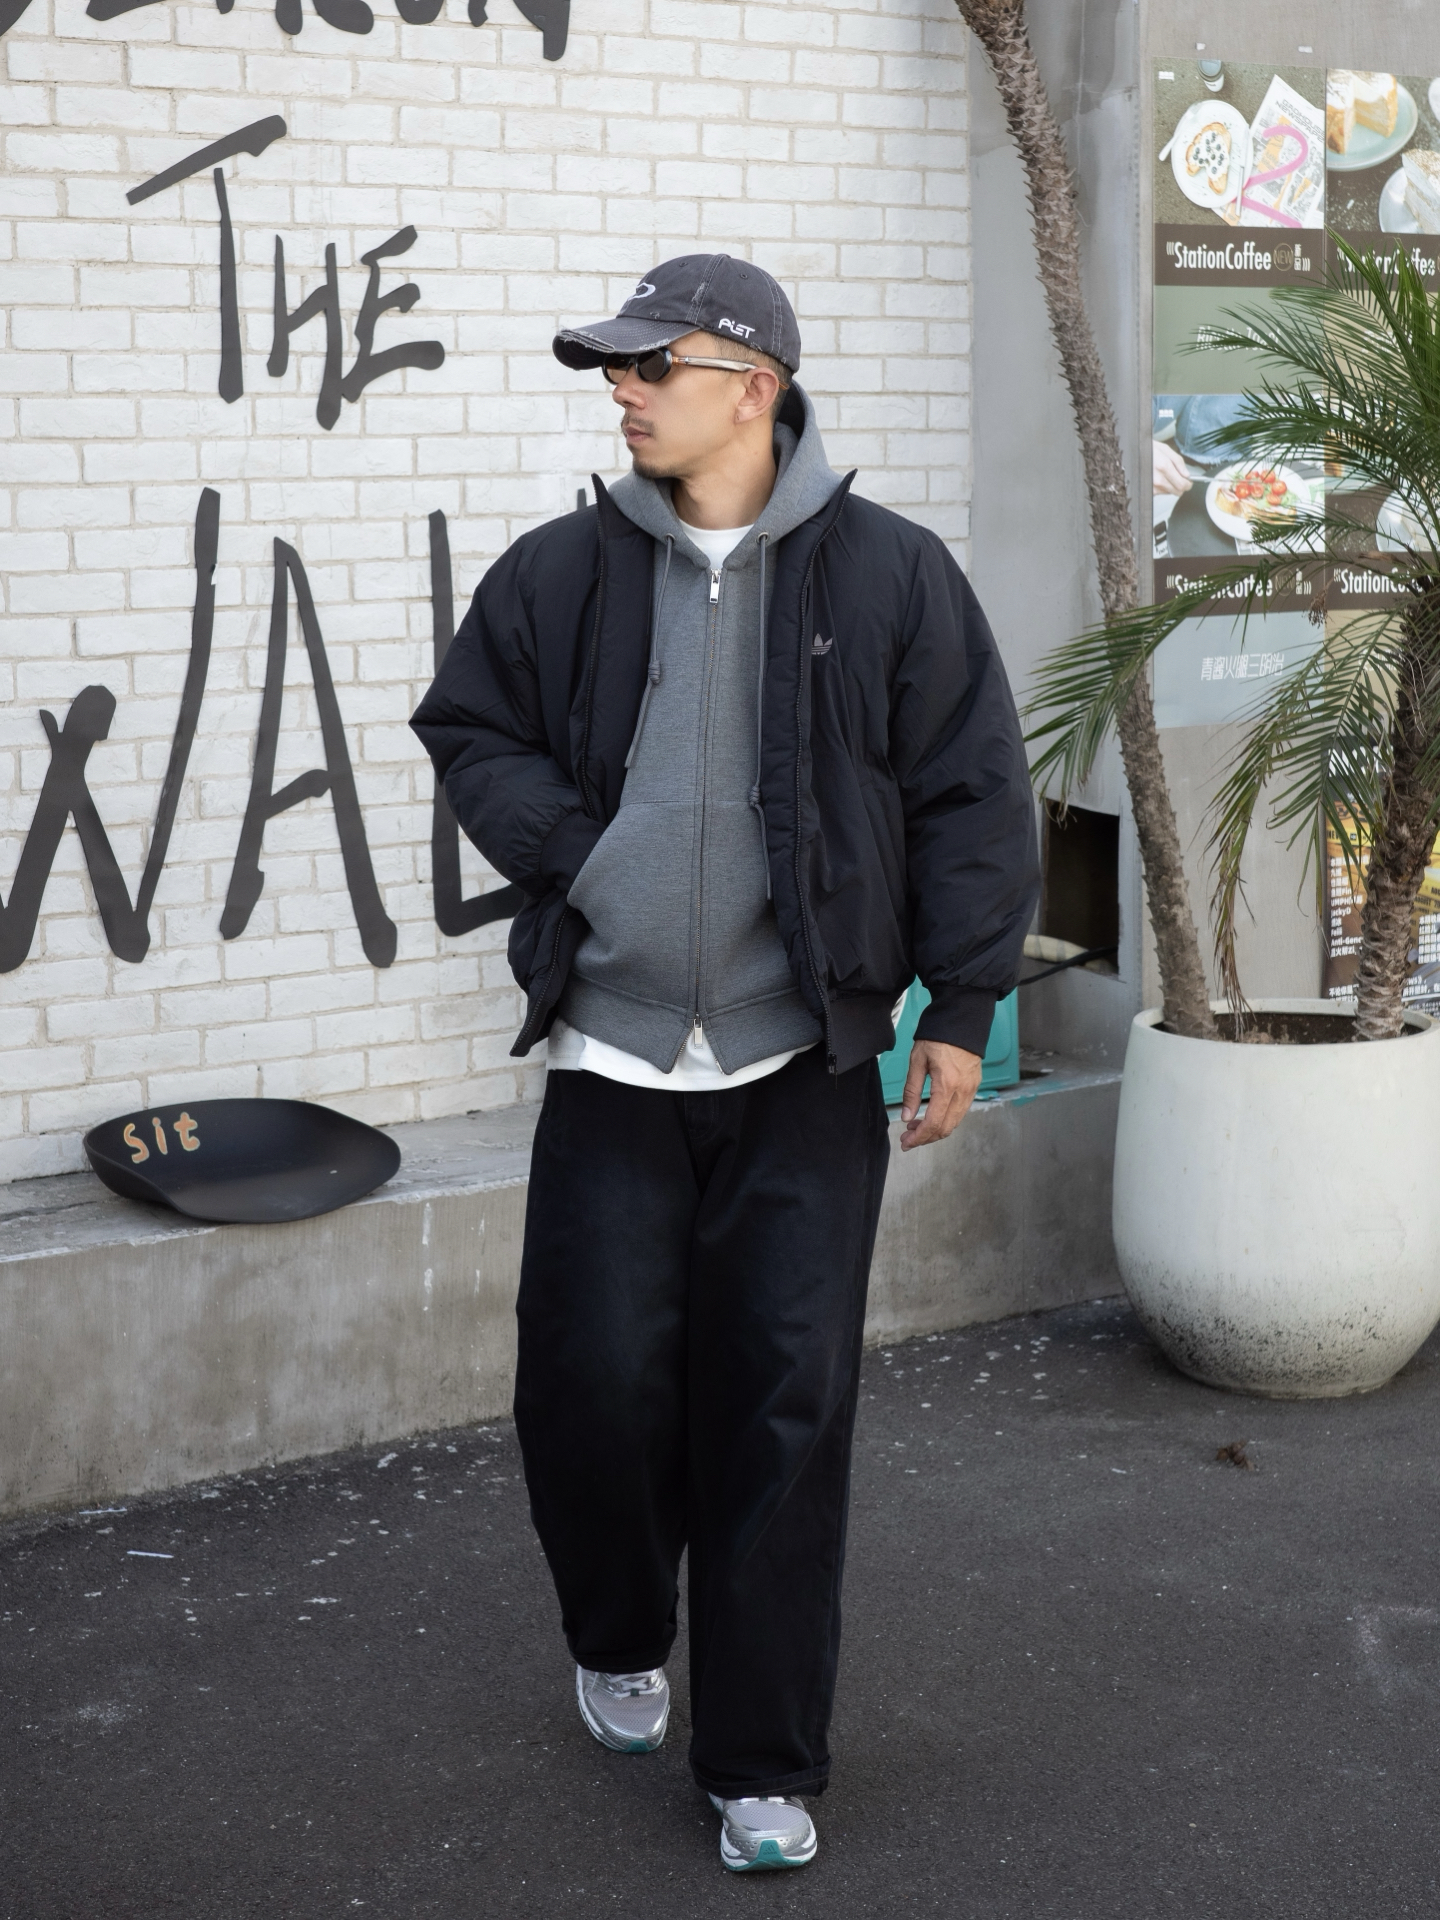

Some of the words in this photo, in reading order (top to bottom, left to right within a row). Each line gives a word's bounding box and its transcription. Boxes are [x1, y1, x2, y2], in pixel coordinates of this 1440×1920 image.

[1174, 241, 1272, 270] StationCoffee
[126, 114, 445, 430] THE
[1175, 574, 1273, 600] StatiCoffee
[1341, 567, 1433, 594] StationCo
[0, 487, 587, 972] WAL
